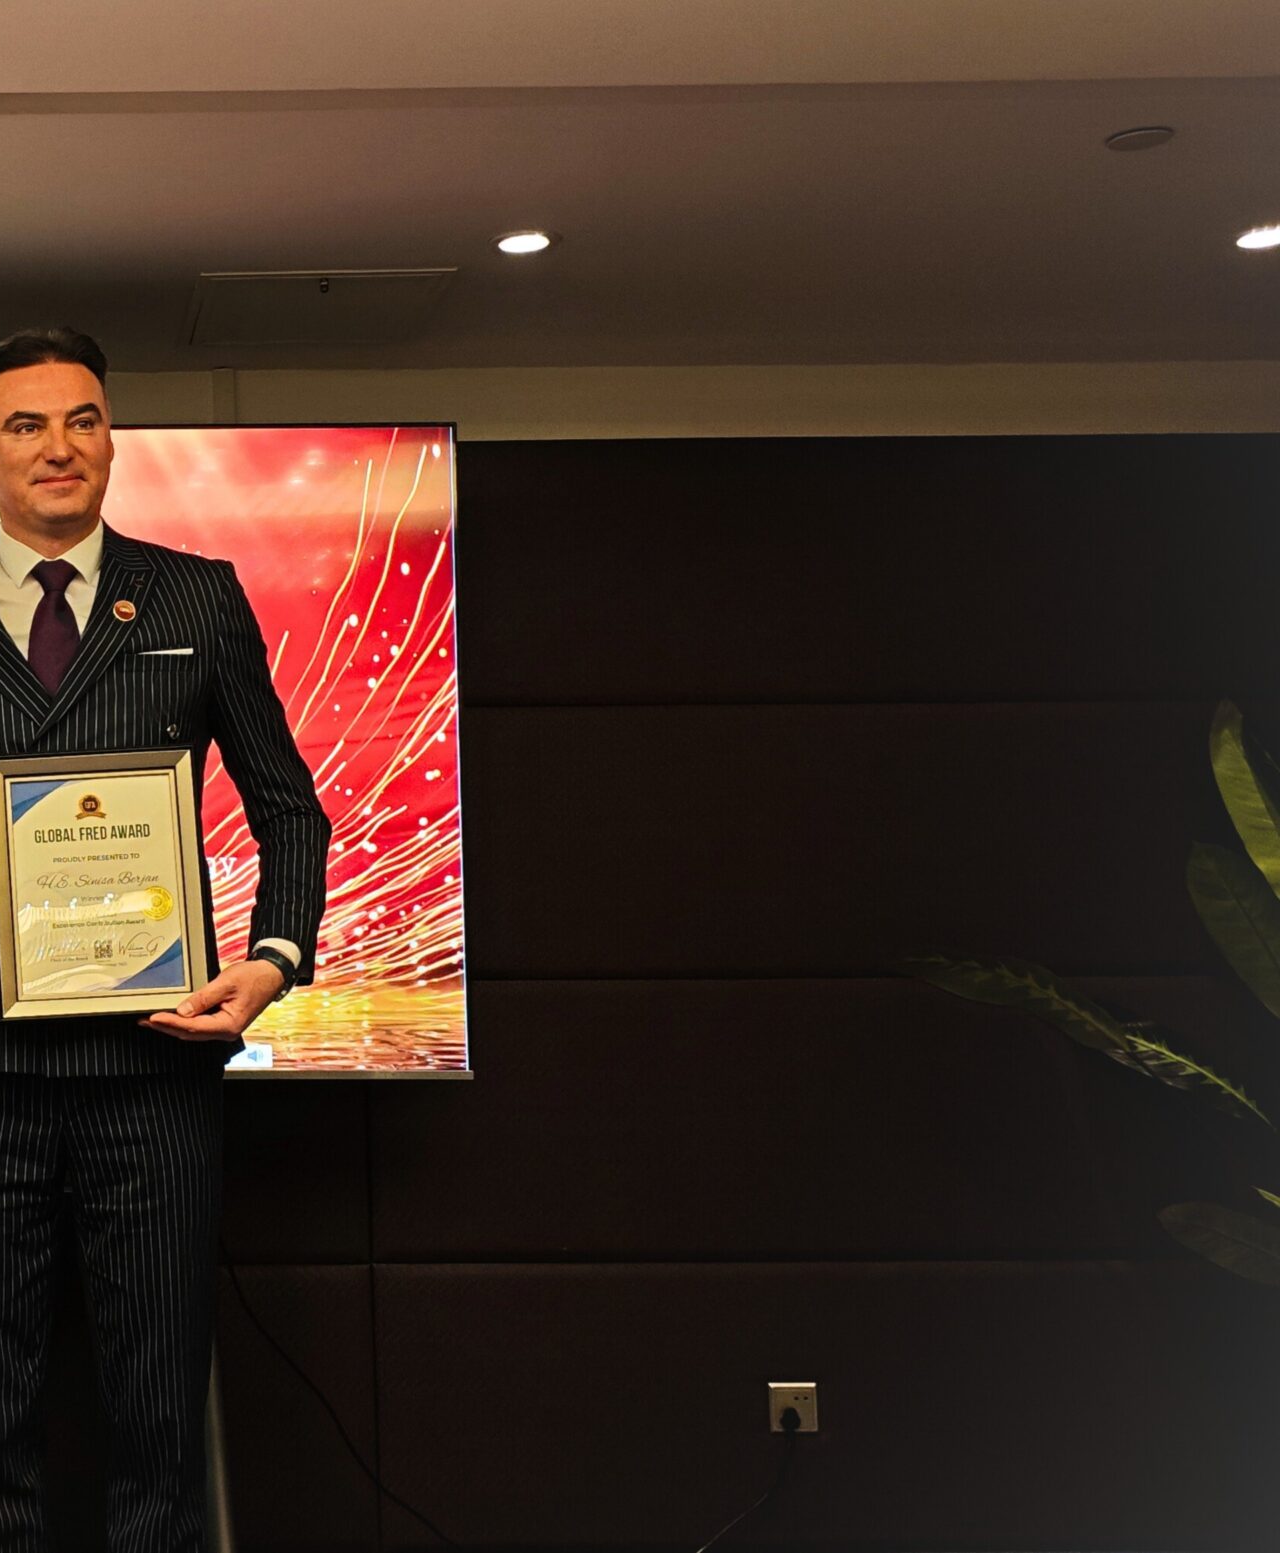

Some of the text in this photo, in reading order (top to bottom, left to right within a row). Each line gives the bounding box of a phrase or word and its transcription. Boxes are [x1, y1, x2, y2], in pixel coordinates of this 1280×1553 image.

[34, 824, 151, 843] GLOBAL FRED AWARD
[52, 855, 86, 863] PROUDLY
[87, 853, 129, 861] PRESENTED
[118, 871, 159, 886] Berjan
